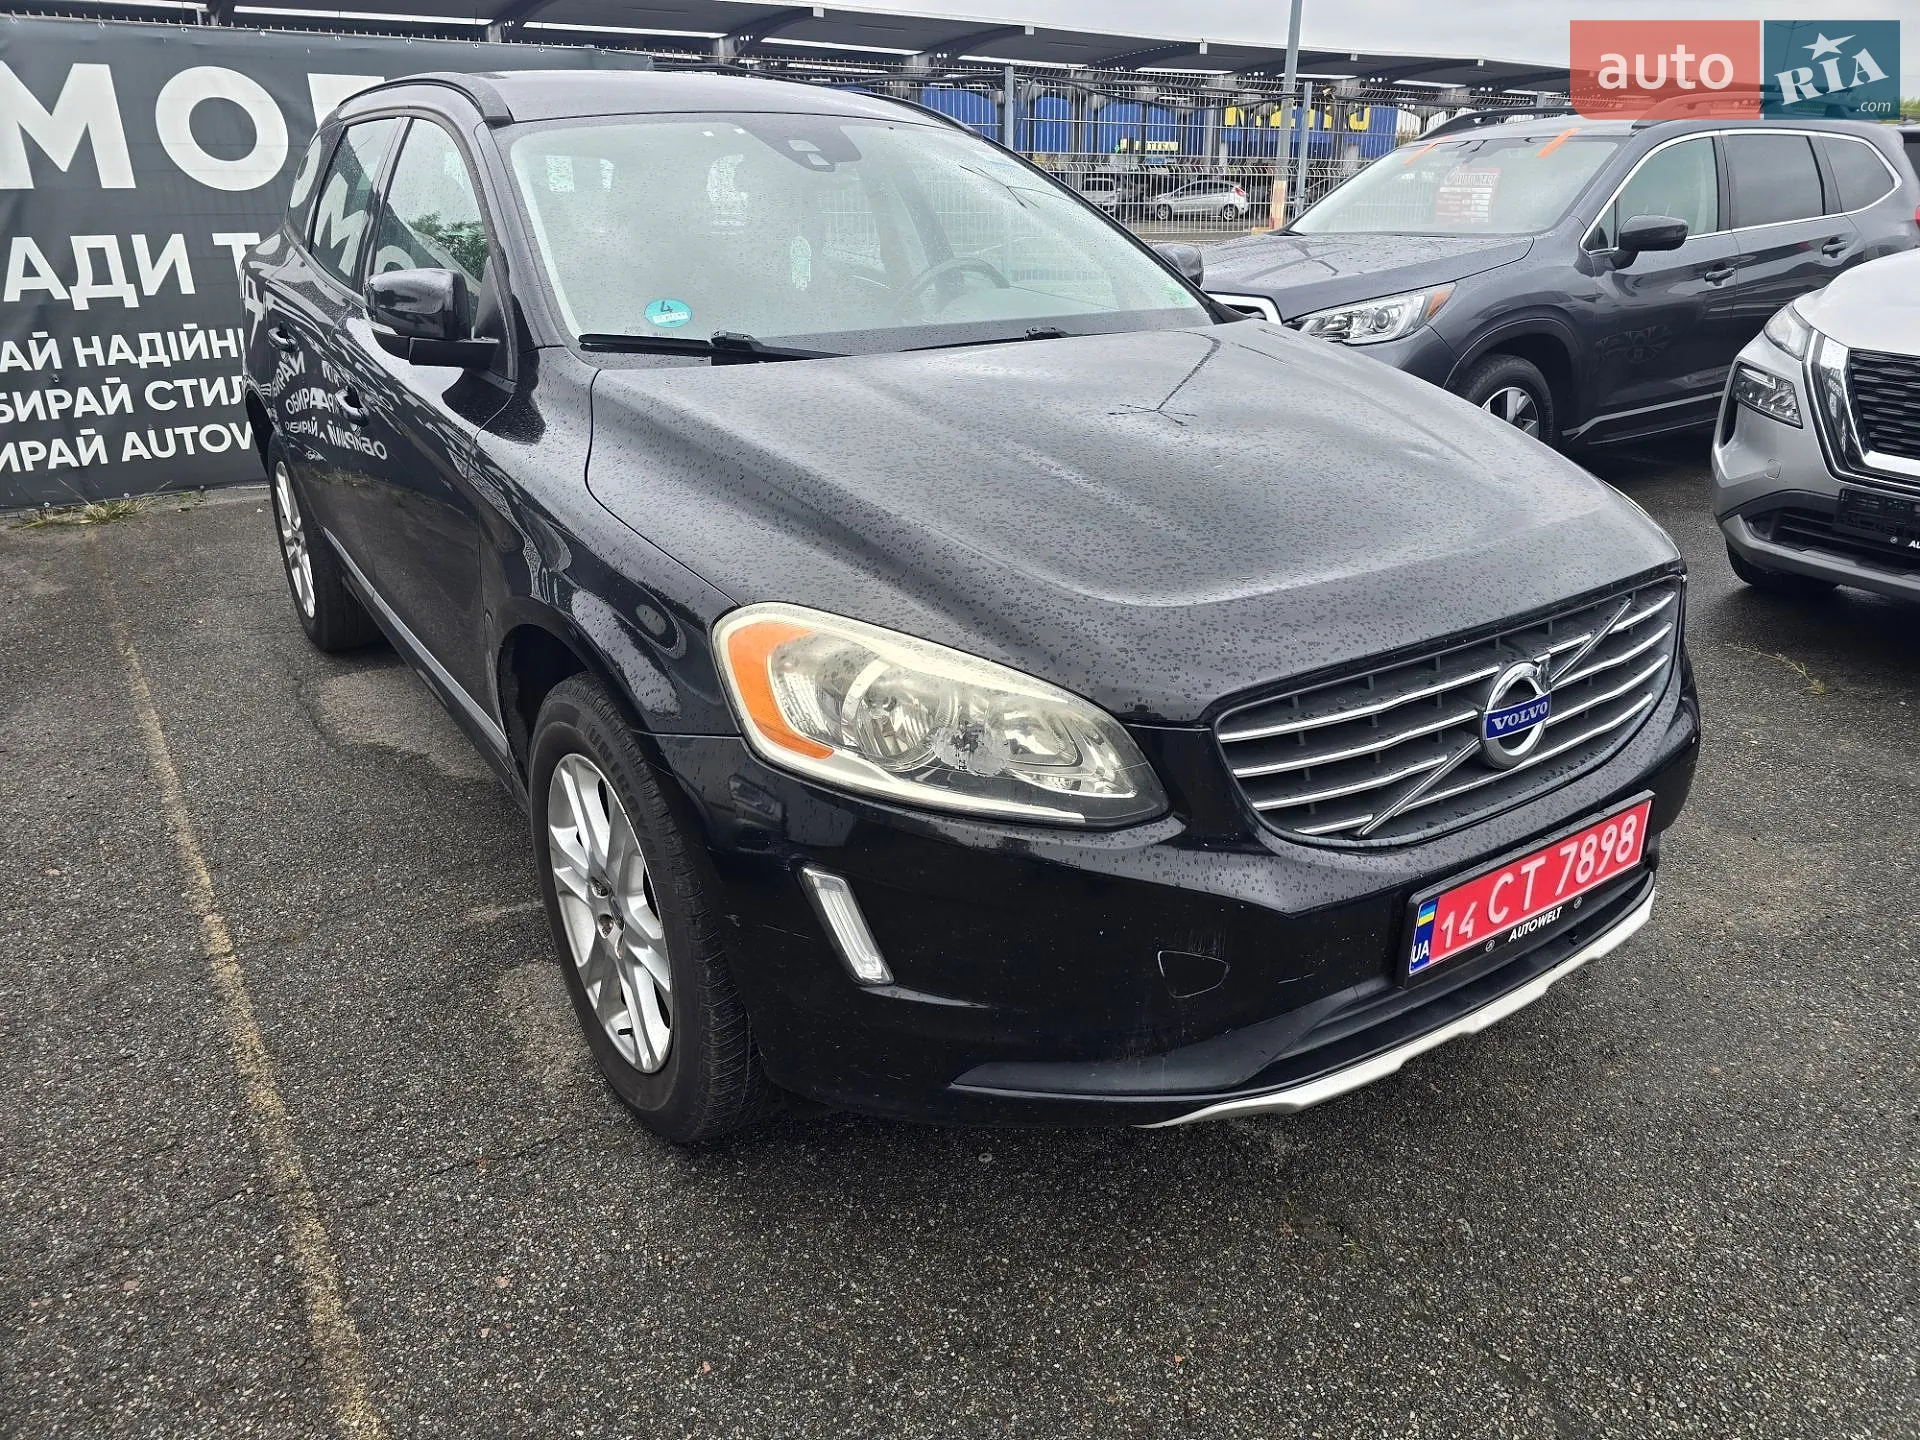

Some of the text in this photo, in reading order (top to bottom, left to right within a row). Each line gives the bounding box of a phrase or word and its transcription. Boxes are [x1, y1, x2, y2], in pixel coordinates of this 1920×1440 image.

[4, 233, 195, 311] АДИ
[0, 331, 63, 373] АЙ
[1492, 700, 1550, 730] VOLVO
[1441, 901, 1477, 949] 14
[1554, 814, 1638, 897] 7898
[1508, 907, 1563, 943] AUTOWELT
[1412, 945, 1430, 963] UA
